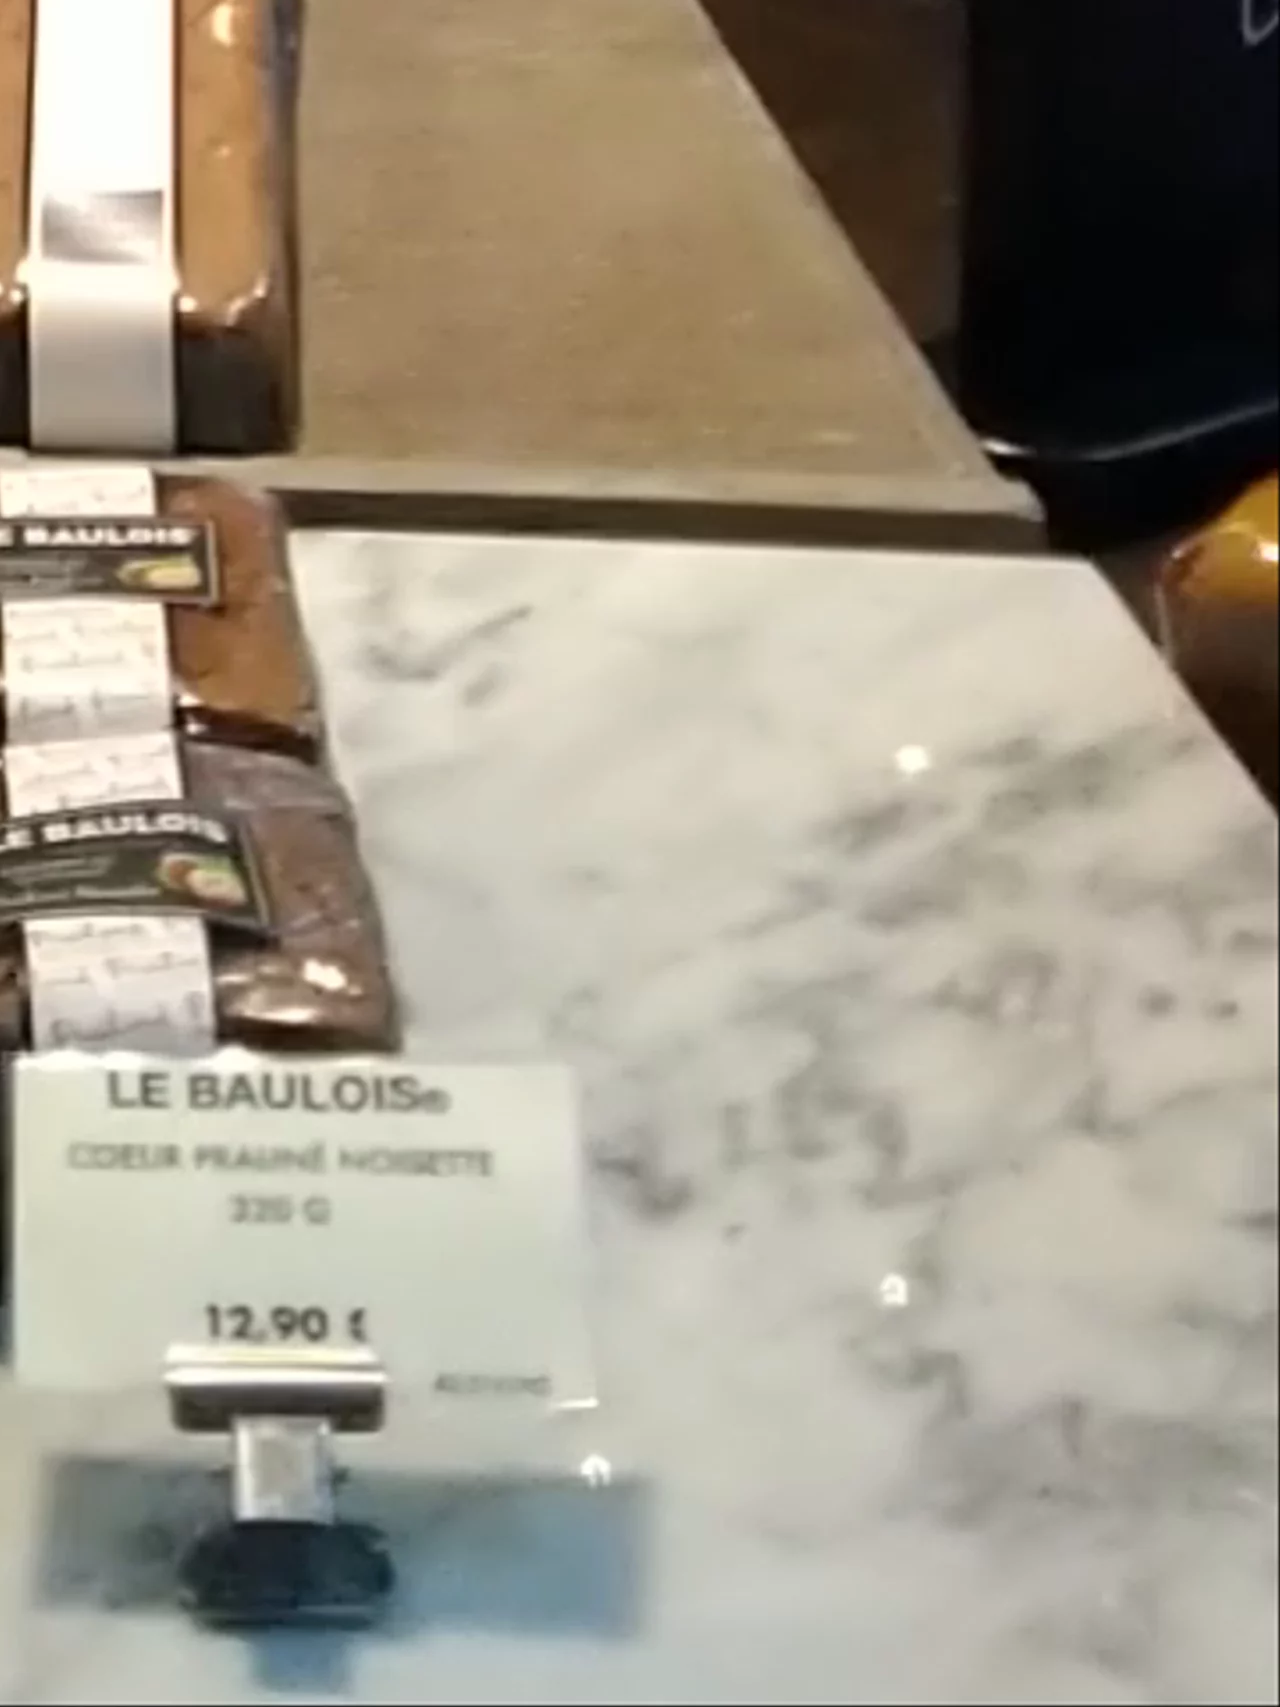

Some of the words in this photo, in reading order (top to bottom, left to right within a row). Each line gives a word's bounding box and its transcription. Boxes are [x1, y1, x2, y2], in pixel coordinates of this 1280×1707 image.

[107, 1071, 170, 1110] LE
[66, 1142, 182, 1169] COEUR
[193, 1138, 326, 1176] PRALINÉ
[338, 1148, 494, 1179] NOISETTE
[302, 1194, 333, 1225] G
